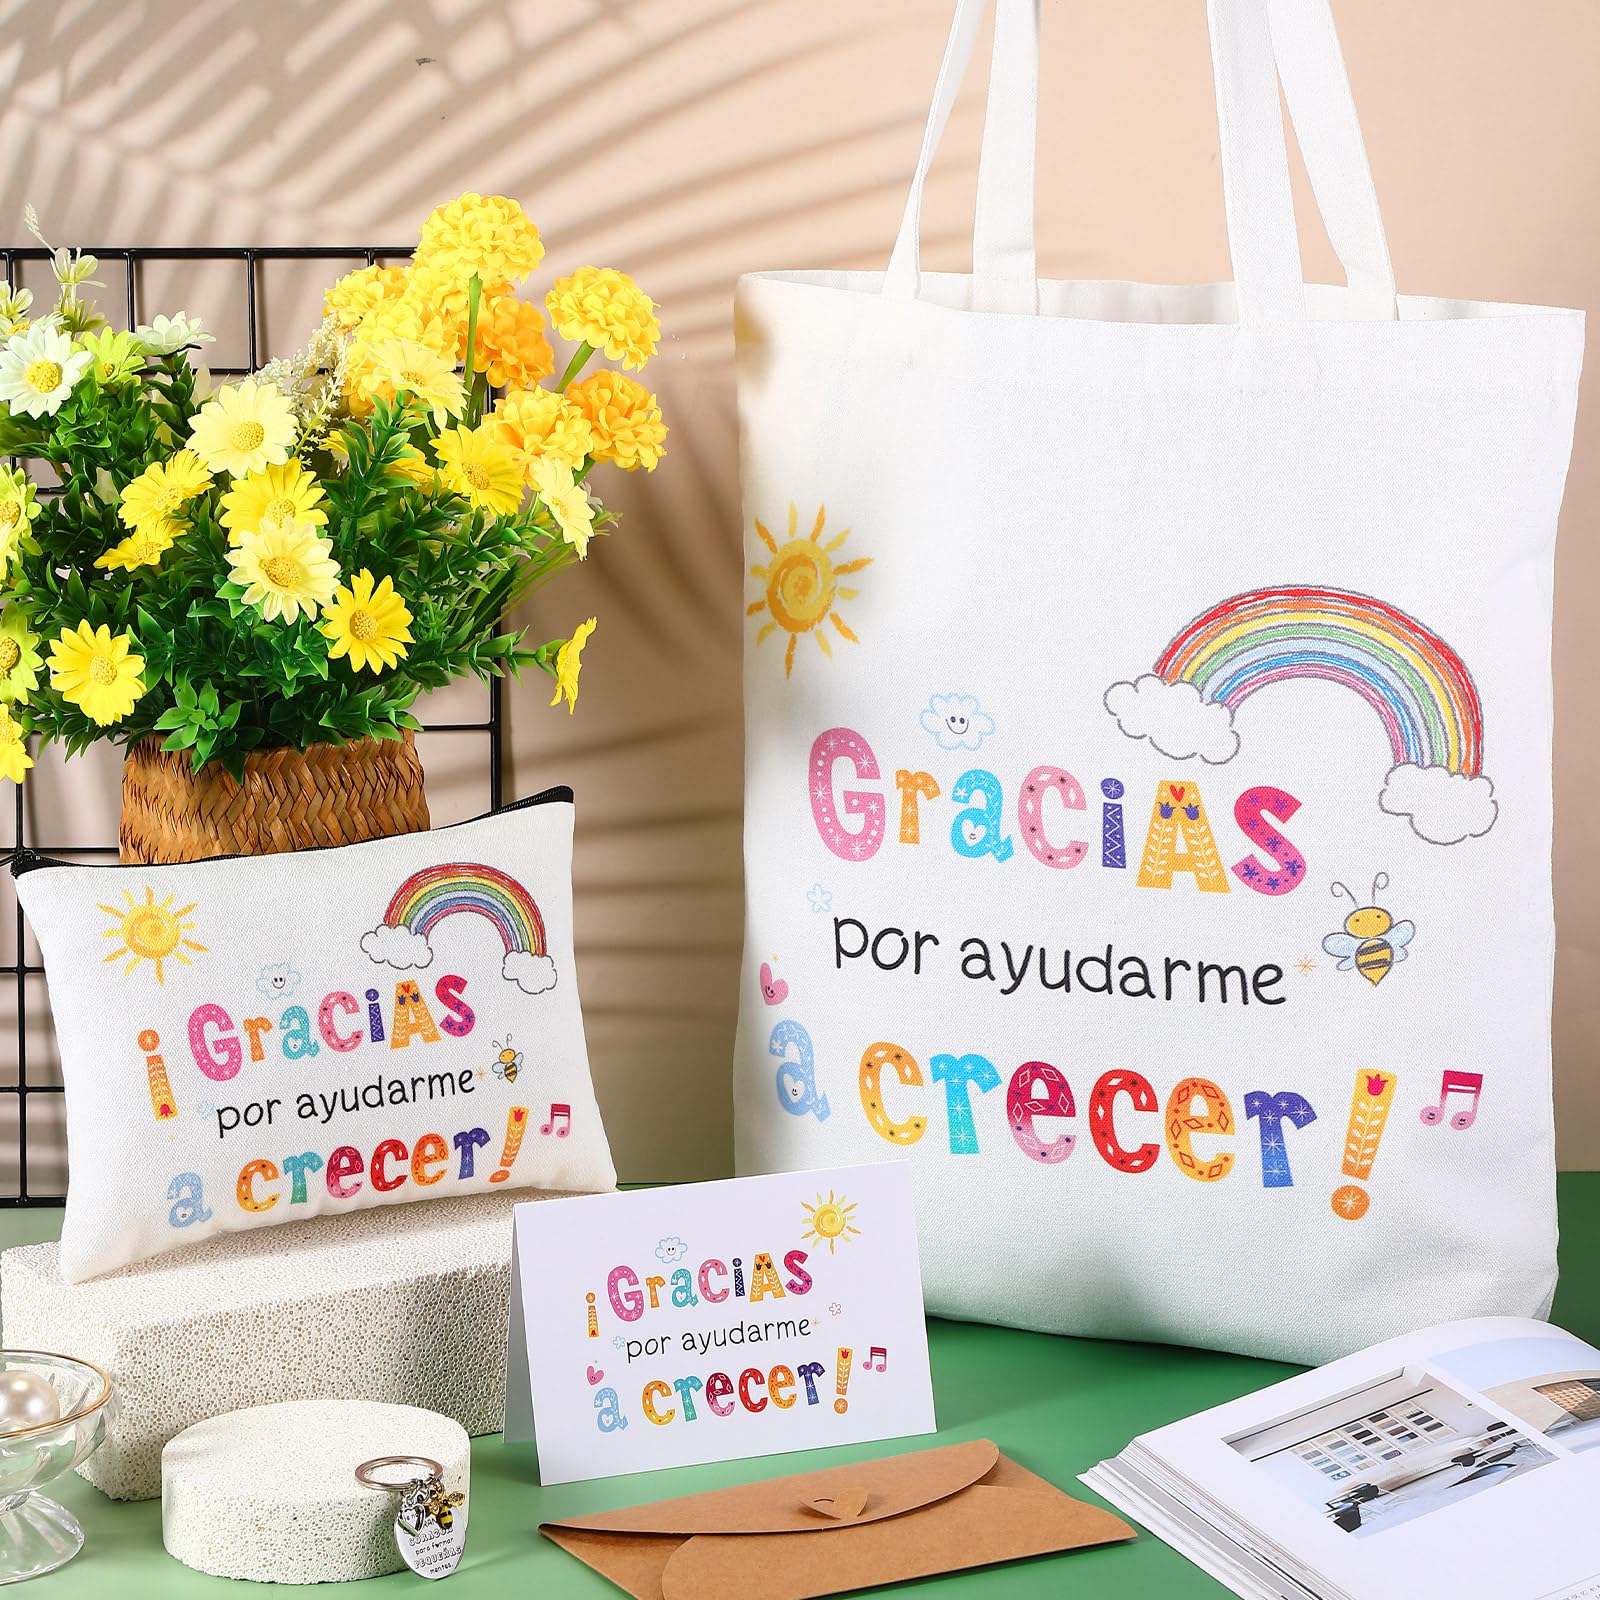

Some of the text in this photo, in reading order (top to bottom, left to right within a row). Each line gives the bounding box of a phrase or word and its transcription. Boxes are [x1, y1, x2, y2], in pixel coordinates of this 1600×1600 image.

[834, 917, 1287, 1005] por ayudarme
[217, 1069, 475, 1138] por ayudarme
[769, 1019, 1398, 1221] a crecer!
[167, 1106, 529, 1228] a crecer!
[626, 1318, 812, 1363] por ayudarme
[594, 1347, 853, 1433] a crecer!
[415, 1545, 431, 1556] para
